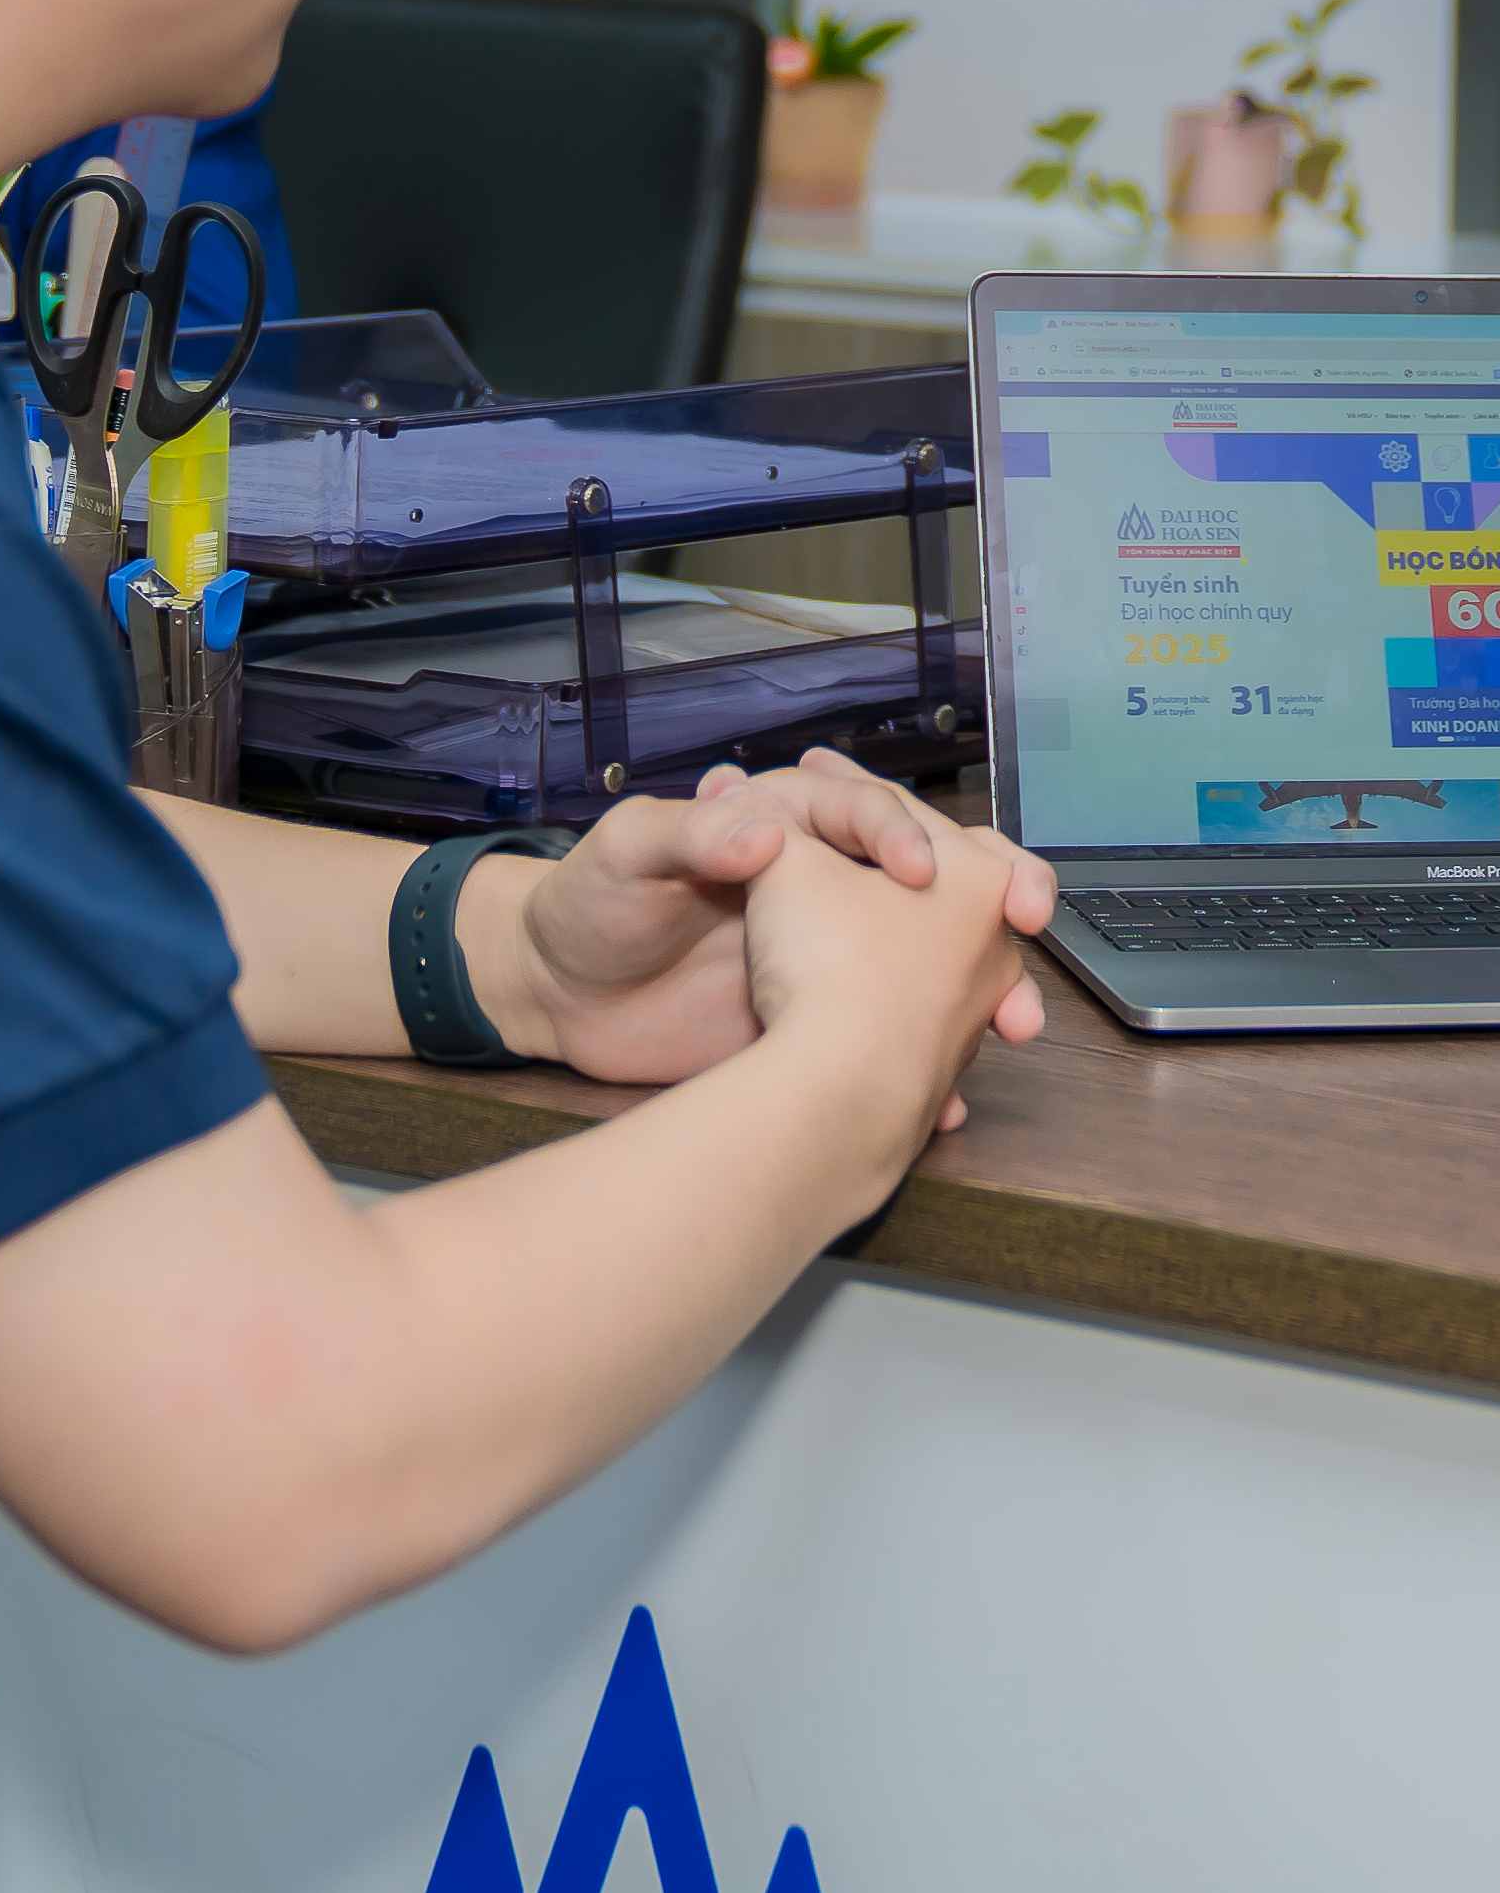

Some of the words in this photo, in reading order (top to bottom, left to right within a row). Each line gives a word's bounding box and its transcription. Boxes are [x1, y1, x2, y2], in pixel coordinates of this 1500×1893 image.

[1161, 527, 1201, 540] HOA
[1205, 527, 1240, 540] SEN
[1387, 551, 1444, 575] HỌC
[1119, 572, 1187, 597] Tuyển
[1193, 575, 1239, 593] sinh
[1121, 603, 1153, 623] Đại
[1159, 604, 1195, 623] học
[1200, 604, 1252, 620] chính
[1258, 606, 1293, 623] quy
[1124, 633, 1231, 666] 2025
[1127, 686, 1148, 716] 5
[1231, 686, 1272, 715] 31
[1411, 718, 1449, 733] KINH
[1427, 865, 1485, 879] MacBook
